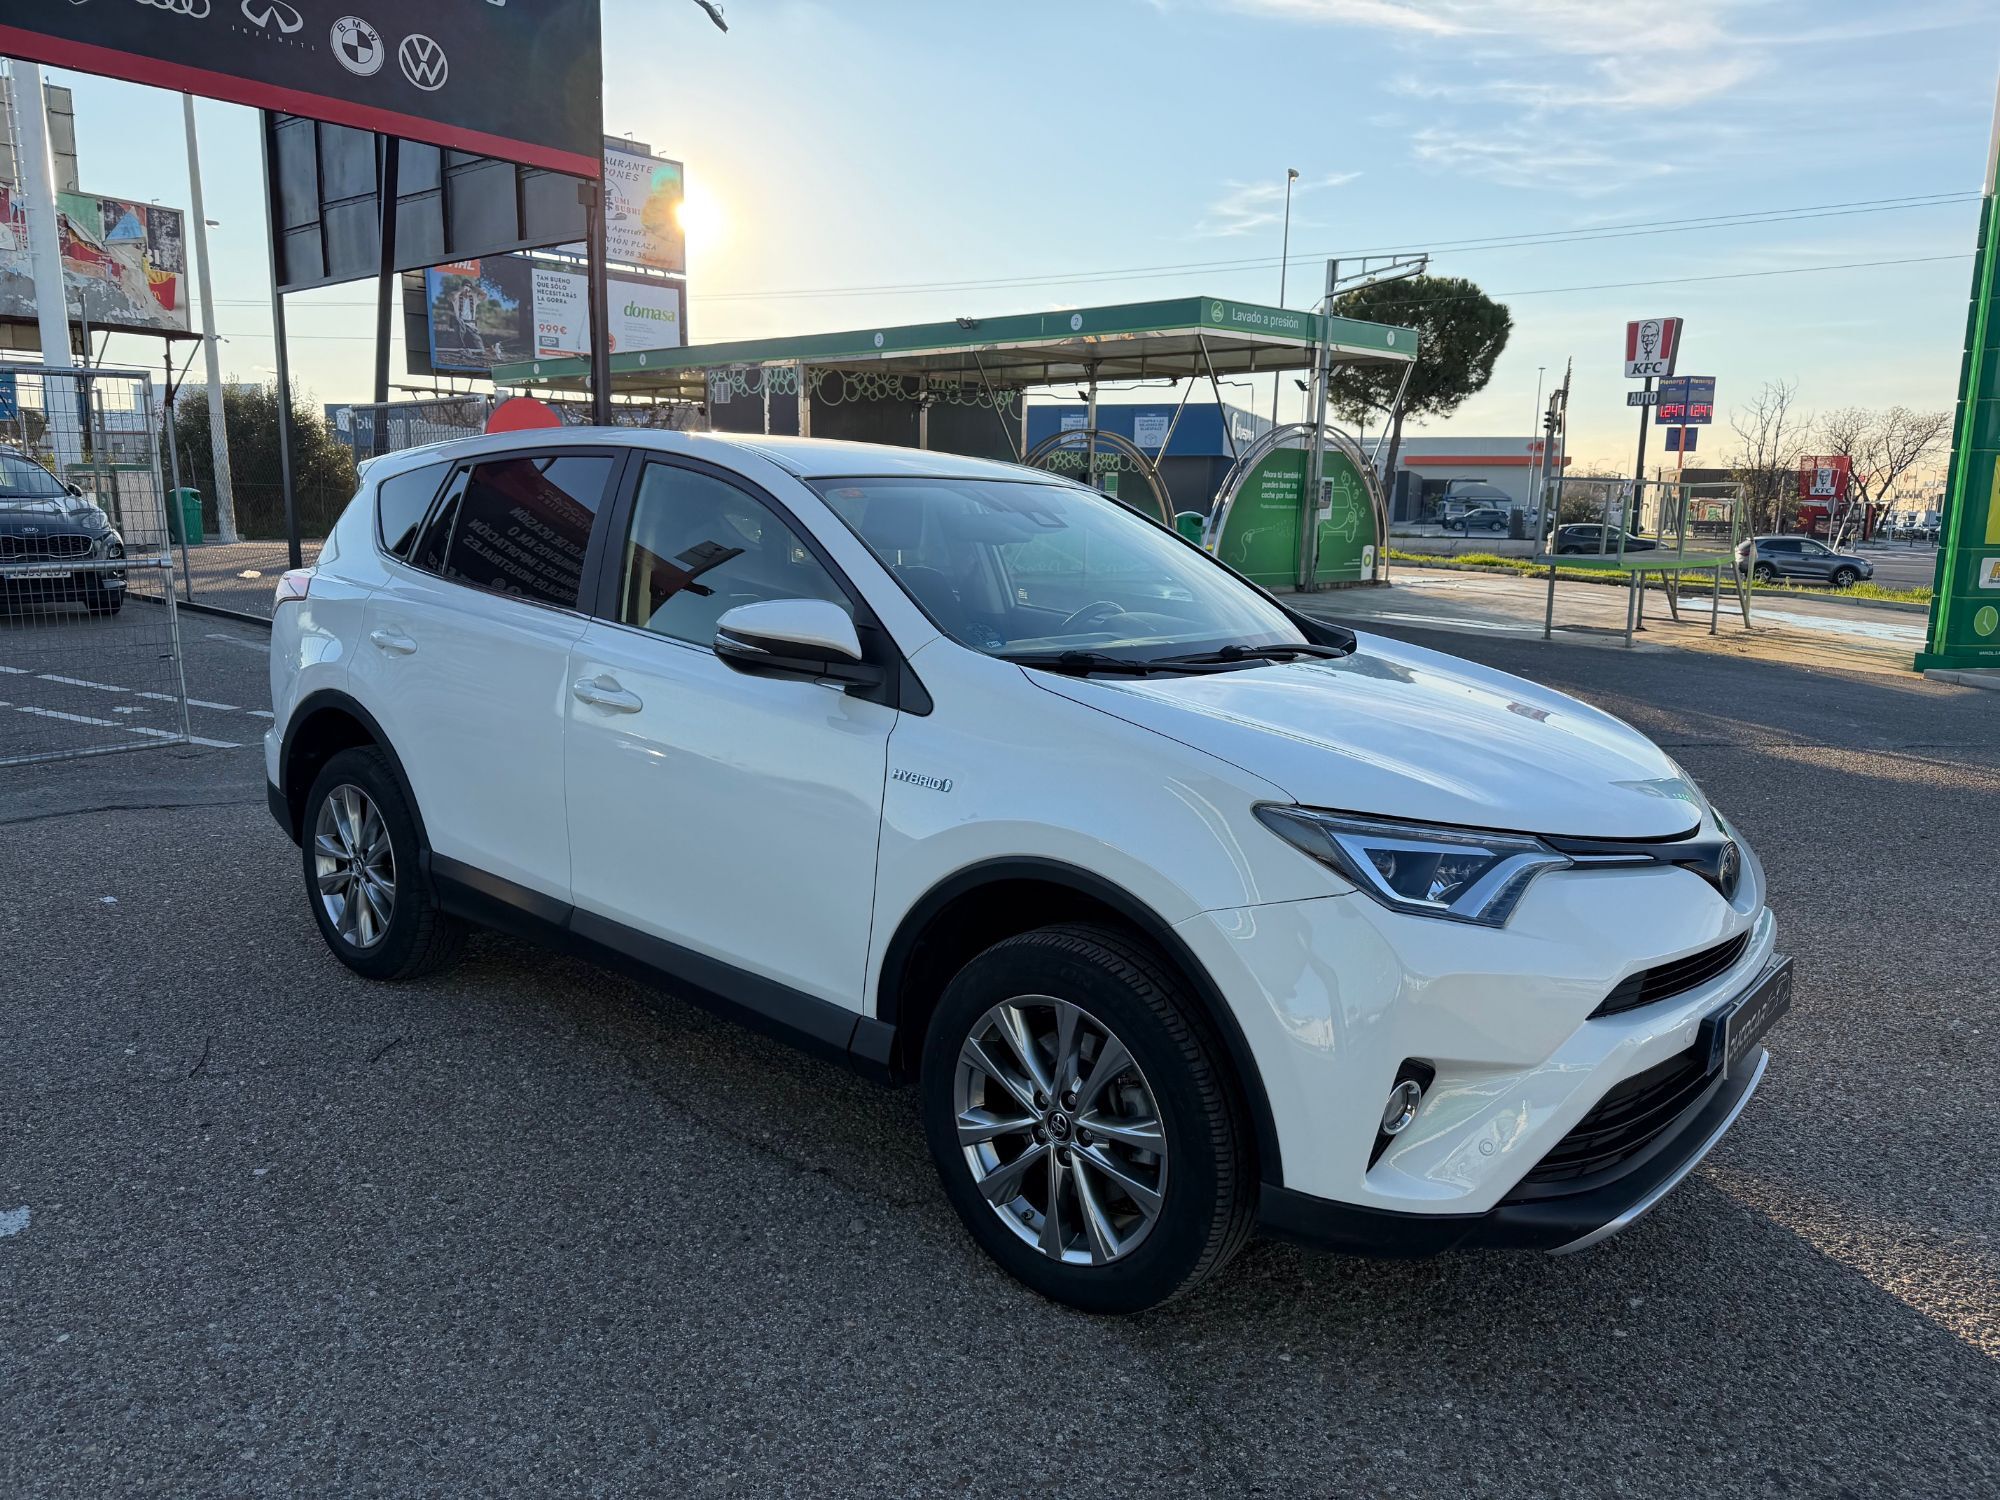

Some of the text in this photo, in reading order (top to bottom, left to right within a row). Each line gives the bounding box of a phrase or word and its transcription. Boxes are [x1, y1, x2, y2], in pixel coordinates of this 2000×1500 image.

[335, 19, 379, 43] BMW
[536, 281, 549, 289] QUE
[550, 276, 571, 285] BUENO
[624, 300, 676, 322] domasa
[1232, 307, 1299, 329] Lavado a presión
[1631, 361, 1663, 375] KFC
[1629, 391, 1658, 406] AUTO
[1262, 469, 1277, 478] Ahora
[1261, 481, 1279, 490] puedes
[1279, 480, 1291, 489] lavar
[1813, 486, 1832, 494] KFC
[1261, 490, 1275, 499] coche
[1275, 492, 1284, 501] por
[891, 768, 943, 791] HYBRID
